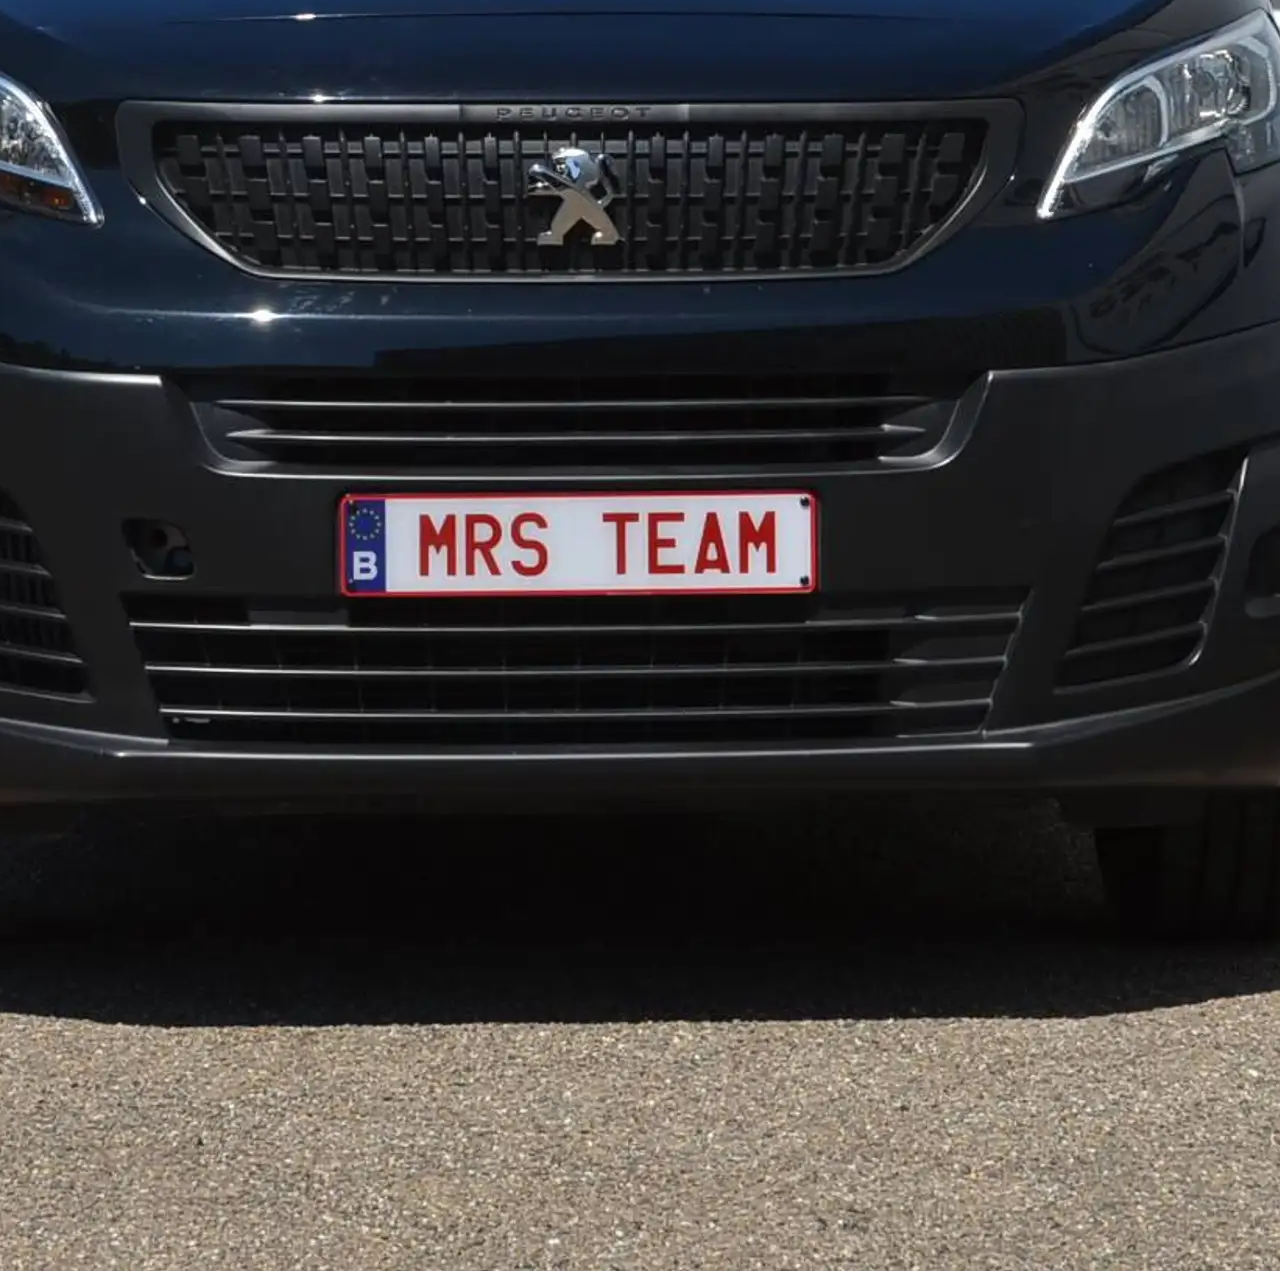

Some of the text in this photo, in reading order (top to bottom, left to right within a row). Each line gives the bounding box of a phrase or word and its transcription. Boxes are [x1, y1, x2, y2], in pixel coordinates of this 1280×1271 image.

[496, 106, 652, 121] PEUGEOT
[419, 510, 777, 577] MRS TEAM
[352, 550, 379, 581] B
